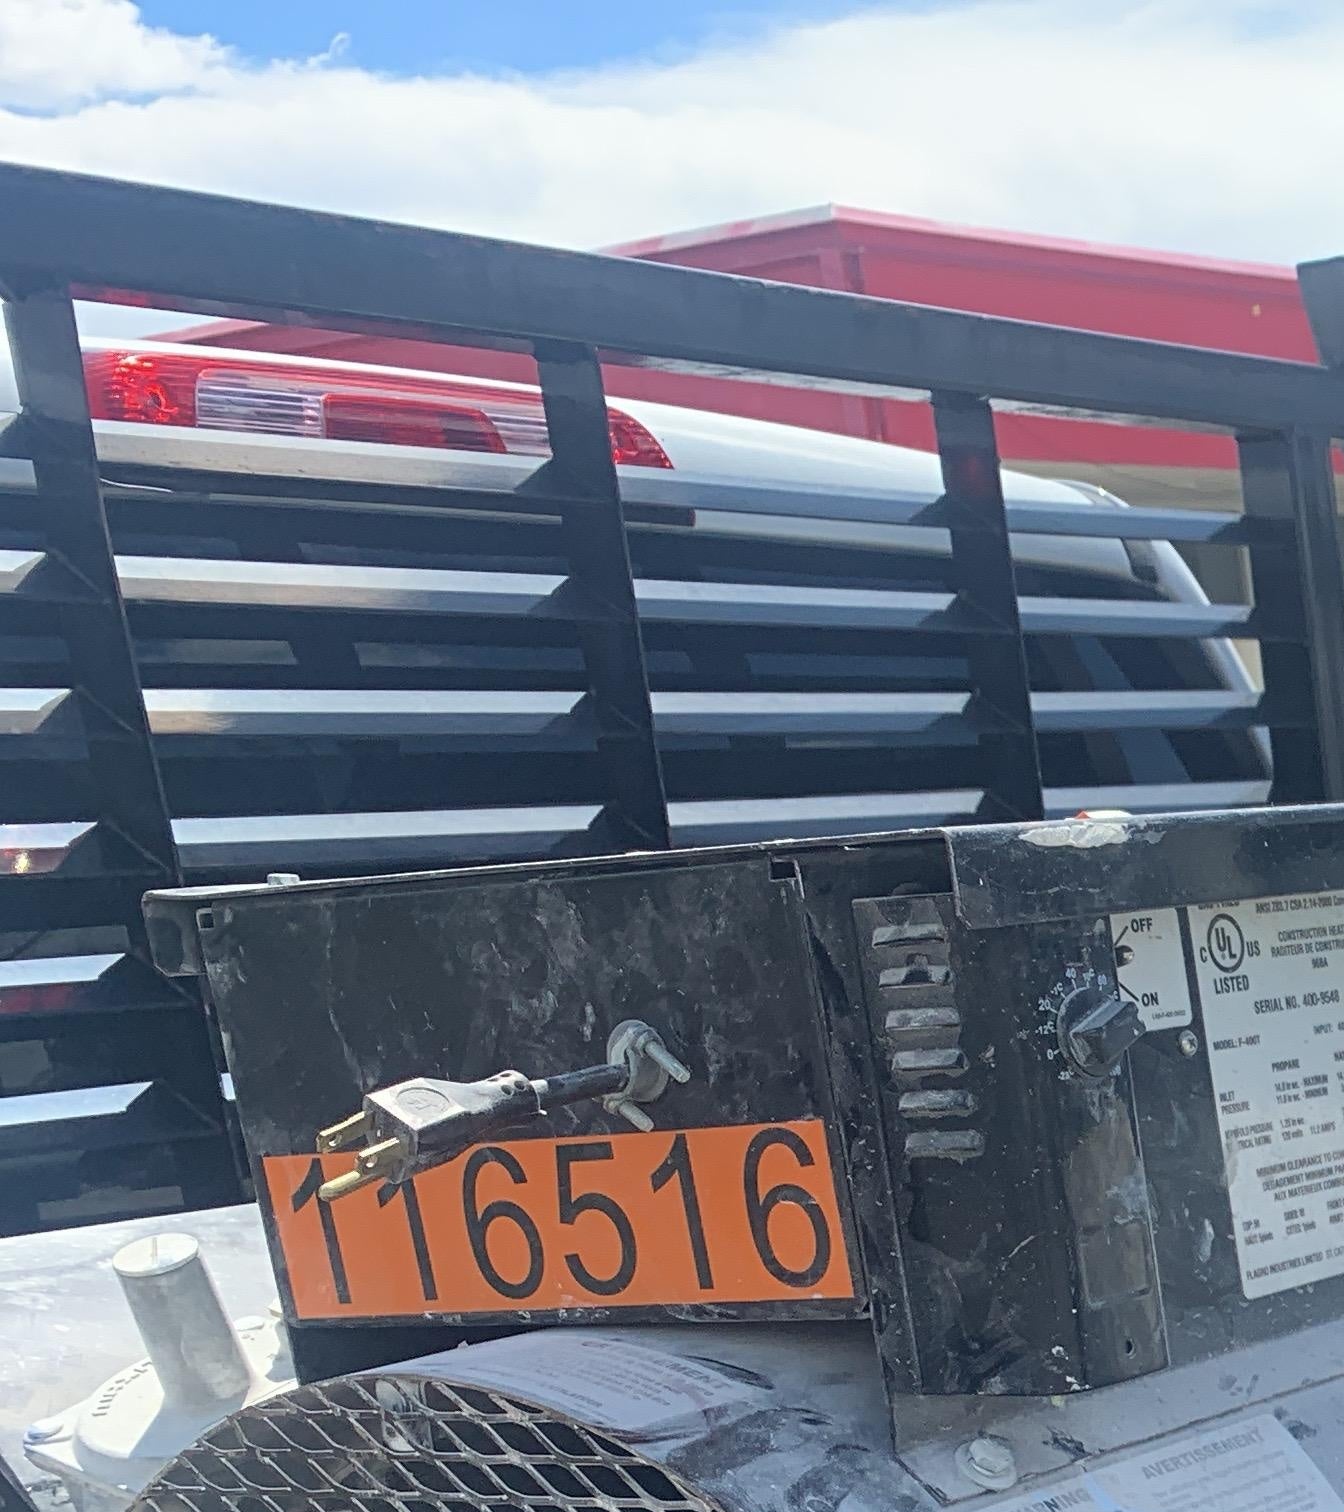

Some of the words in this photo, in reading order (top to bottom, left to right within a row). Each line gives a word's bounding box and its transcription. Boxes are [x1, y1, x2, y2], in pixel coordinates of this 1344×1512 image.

[1131, 918, 1153, 933] OFF
[1278, 926, 1327, 942] CONSTRUCTION
[1215, 928, 1235, 957] UL
[1246, 940, 1260, 955] US
[1304, 942, 1313, 952] DE
[1199, 948, 1207, 962] C
[1213, 975, 1249, 994] LISTED
[1141, 992, 1160, 1007] ON
[1253, 998, 1284, 1014] SERIAL
[1285, 996, 1300, 1009] NO.
[1313, 1023, 1333, 1034] INPUT:
[1212, 1038, 1237, 1050] MODEL:
[1271, 1058, 1300, 1071] PROPANE
[1219, 1091, 1235, 1102] INLET
[1221, 1101, 1250, 1114] PRESSURE
[1320, 1122, 1336, 1132] AMPS
[1256, 1163, 1286, 1177] MINIMUM
[1286, 1155, 1323, 1170] CLEARANCE
[1324, 1153, 1332, 1162] TO
[1304, 1167, 1334, 1181] MINIMUM
[1273, 1190, 1287, 1201] AUX
[292, 1127, 831, 1304] 116516
[1246, 1266, 1269, 1279] FLAGRO
[1269, 1258, 1301, 1273] INDUSTRIES
[1301, 1252, 1324, 1265] LIMITED
[1141, 1427, 1263, 1479] AVERTISSEMENT
